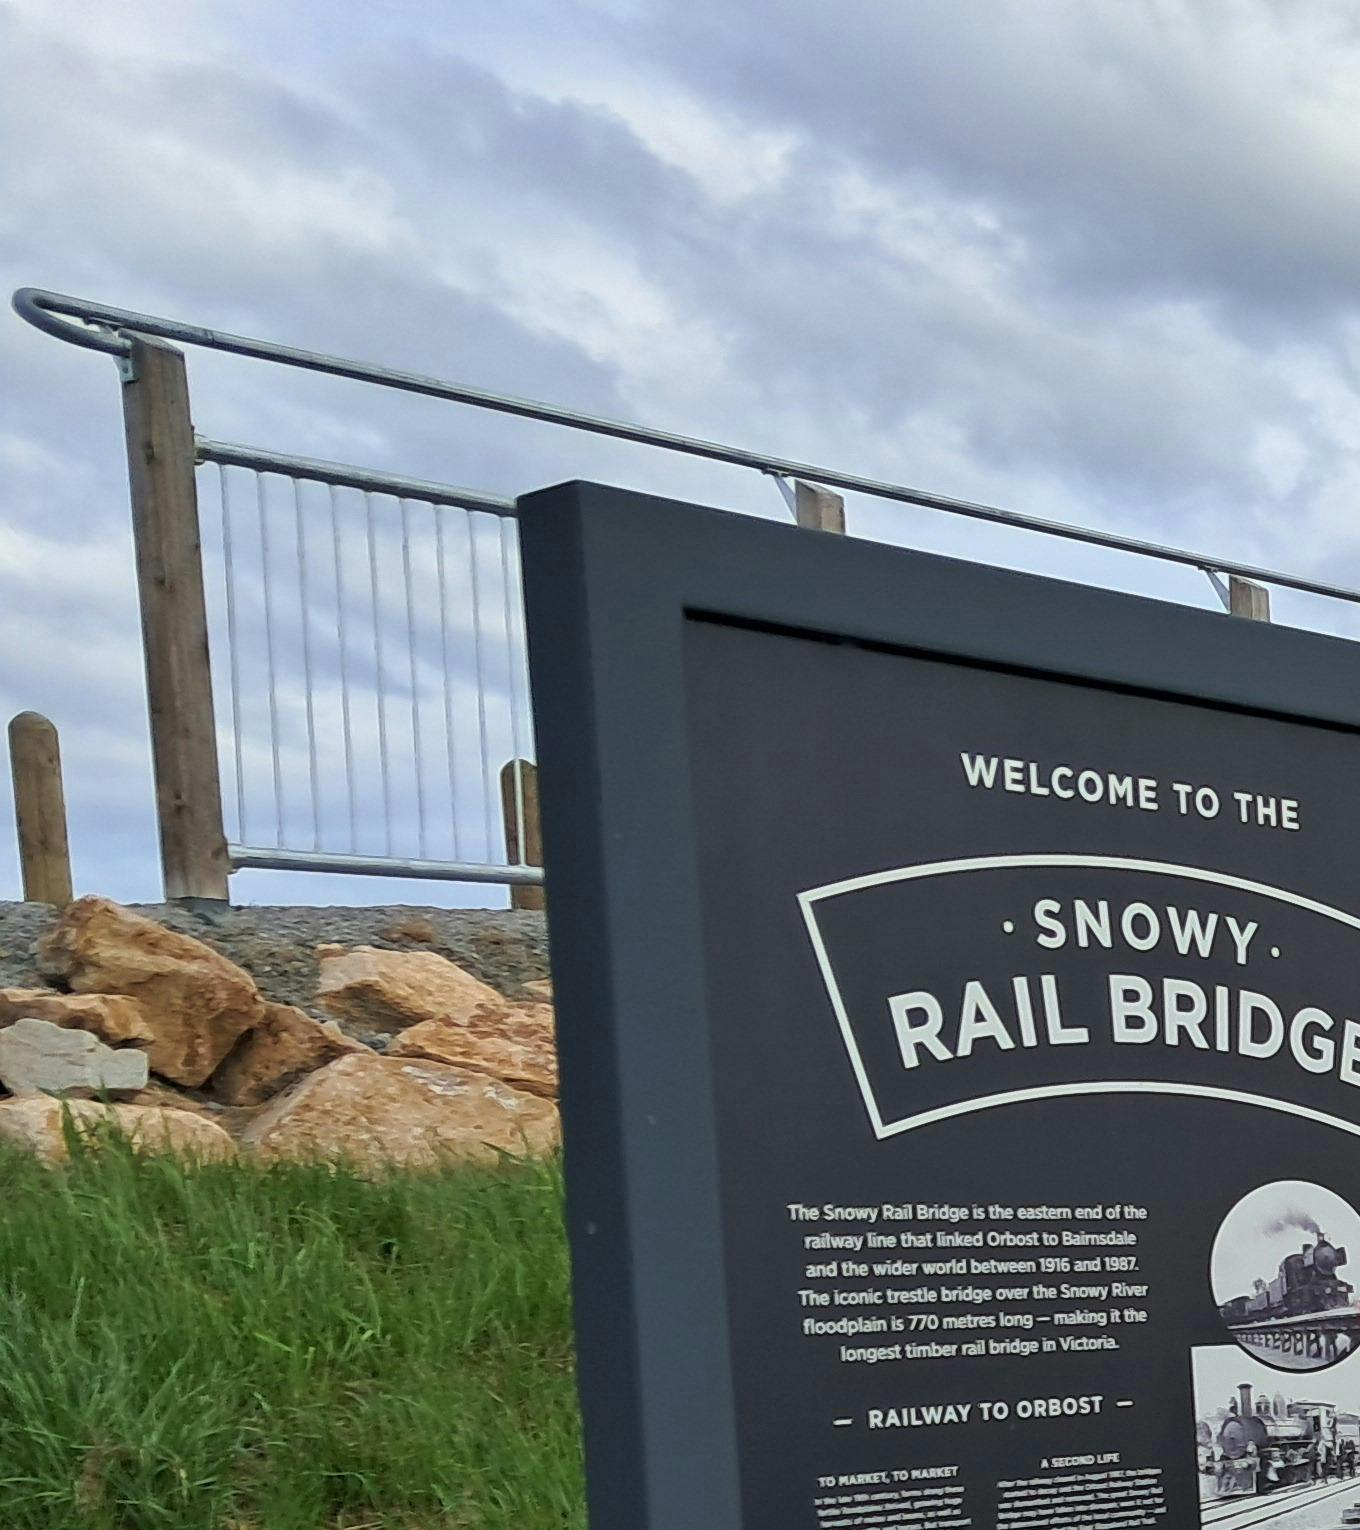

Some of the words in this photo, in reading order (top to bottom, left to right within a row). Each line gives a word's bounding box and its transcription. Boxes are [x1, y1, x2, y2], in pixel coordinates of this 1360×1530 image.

[961, 753, 1158, 810] WELCOME
[1173, 783, 1219, 817] TO
[1234, 792, 1299, 829] THE
[1035, 900, 1257, 964] SNOWY
[888, 975, 1089, 1068] RAIL
[787, 1204, 819, 1220] The
[824, 1204, 878, 1222] Snowy
[882, 1205, 912, 1219] Rail
[917, 1204, 969, 1222] Bridge
[973, 1204, 985, 1219] is
[989, 1205, 1013, 1219] the
[1017, 1206, 1072, 1219] eastern
[1075, 1205, 1102, 1219] end
[1106, 1205, 1121, 1219] of
[1124, 1205, 1147, 1219] the
[805, 1233, 863, 1250] railway
[867, 1233, 896, 1247] line
[901, 1232, 933, 1247] that
[937, 1232, 983, 1246] linked
[987, 1231, 1039, 1246] Orbost
[1042, 1232, 1058, 1245] to
[1062, 1231, 1136, 1245] Bairnsdale
[806, 1261, 837, 1277] and
[841, 1261, 868, 1276] the
[873, 1260, 918, 1275] wider
[922, 1259, 966, 1274] world
[971, 1259, 1036, 1273] between
[1039, 1258, 1070, 1272] 1916
[1074, 1257, 1101, 1271] and
[1104, 1257, 1139, 1271] 1987.
[798, 1290, 829, 1305] The
[834, 1288, 883, 1305] iconic
[887, 1287, 937, 1303] trestle
[941, 1286, 992, 1303] bridge
[996, 1288, 1029, 1300] over
[1033, 1284, 1057, 1299] the
[1061, 1284, 1108, 1300] Snowy
[1112, 1283, 1148, 1296] River
[804, 1317, 887, 1336] floodplain
[891, 1316, 904, 1330] is
[908, 1315, 939, 1330] 770
[943, 1315, 996, 1329] metres
[1000, 1312, 1033, 1328] long
[1054, 1310, 1107, 1326] making
[1111, 1309, 1121, 1322] it
[1124, 1308, 1147, 1322] the
[841, 1345, 901, 1363] longest
[905, 1342, 957, 1358] timber
[962, 1340, 985, 1355] rail
[989, 1339, 1039, 1355] bridge
[1042, 1338, 1056, 1351] in
[1059, 1336, 1119, 1350] Victoria.
[869, 1404, 971, 1428] RAILWAY
[980, 1402, 1008, 1420] TO
[1017, 1396, 1102, 1417] ORBOST
[1041, 1459, 1048, 1468] A
[1097, 1453, 1119, 1463] LIFE
[818, 1477, 835, 1486] TO
[892, 1471, 908, 1480] TO
[911, 1466, 958, 1479] MARKET
